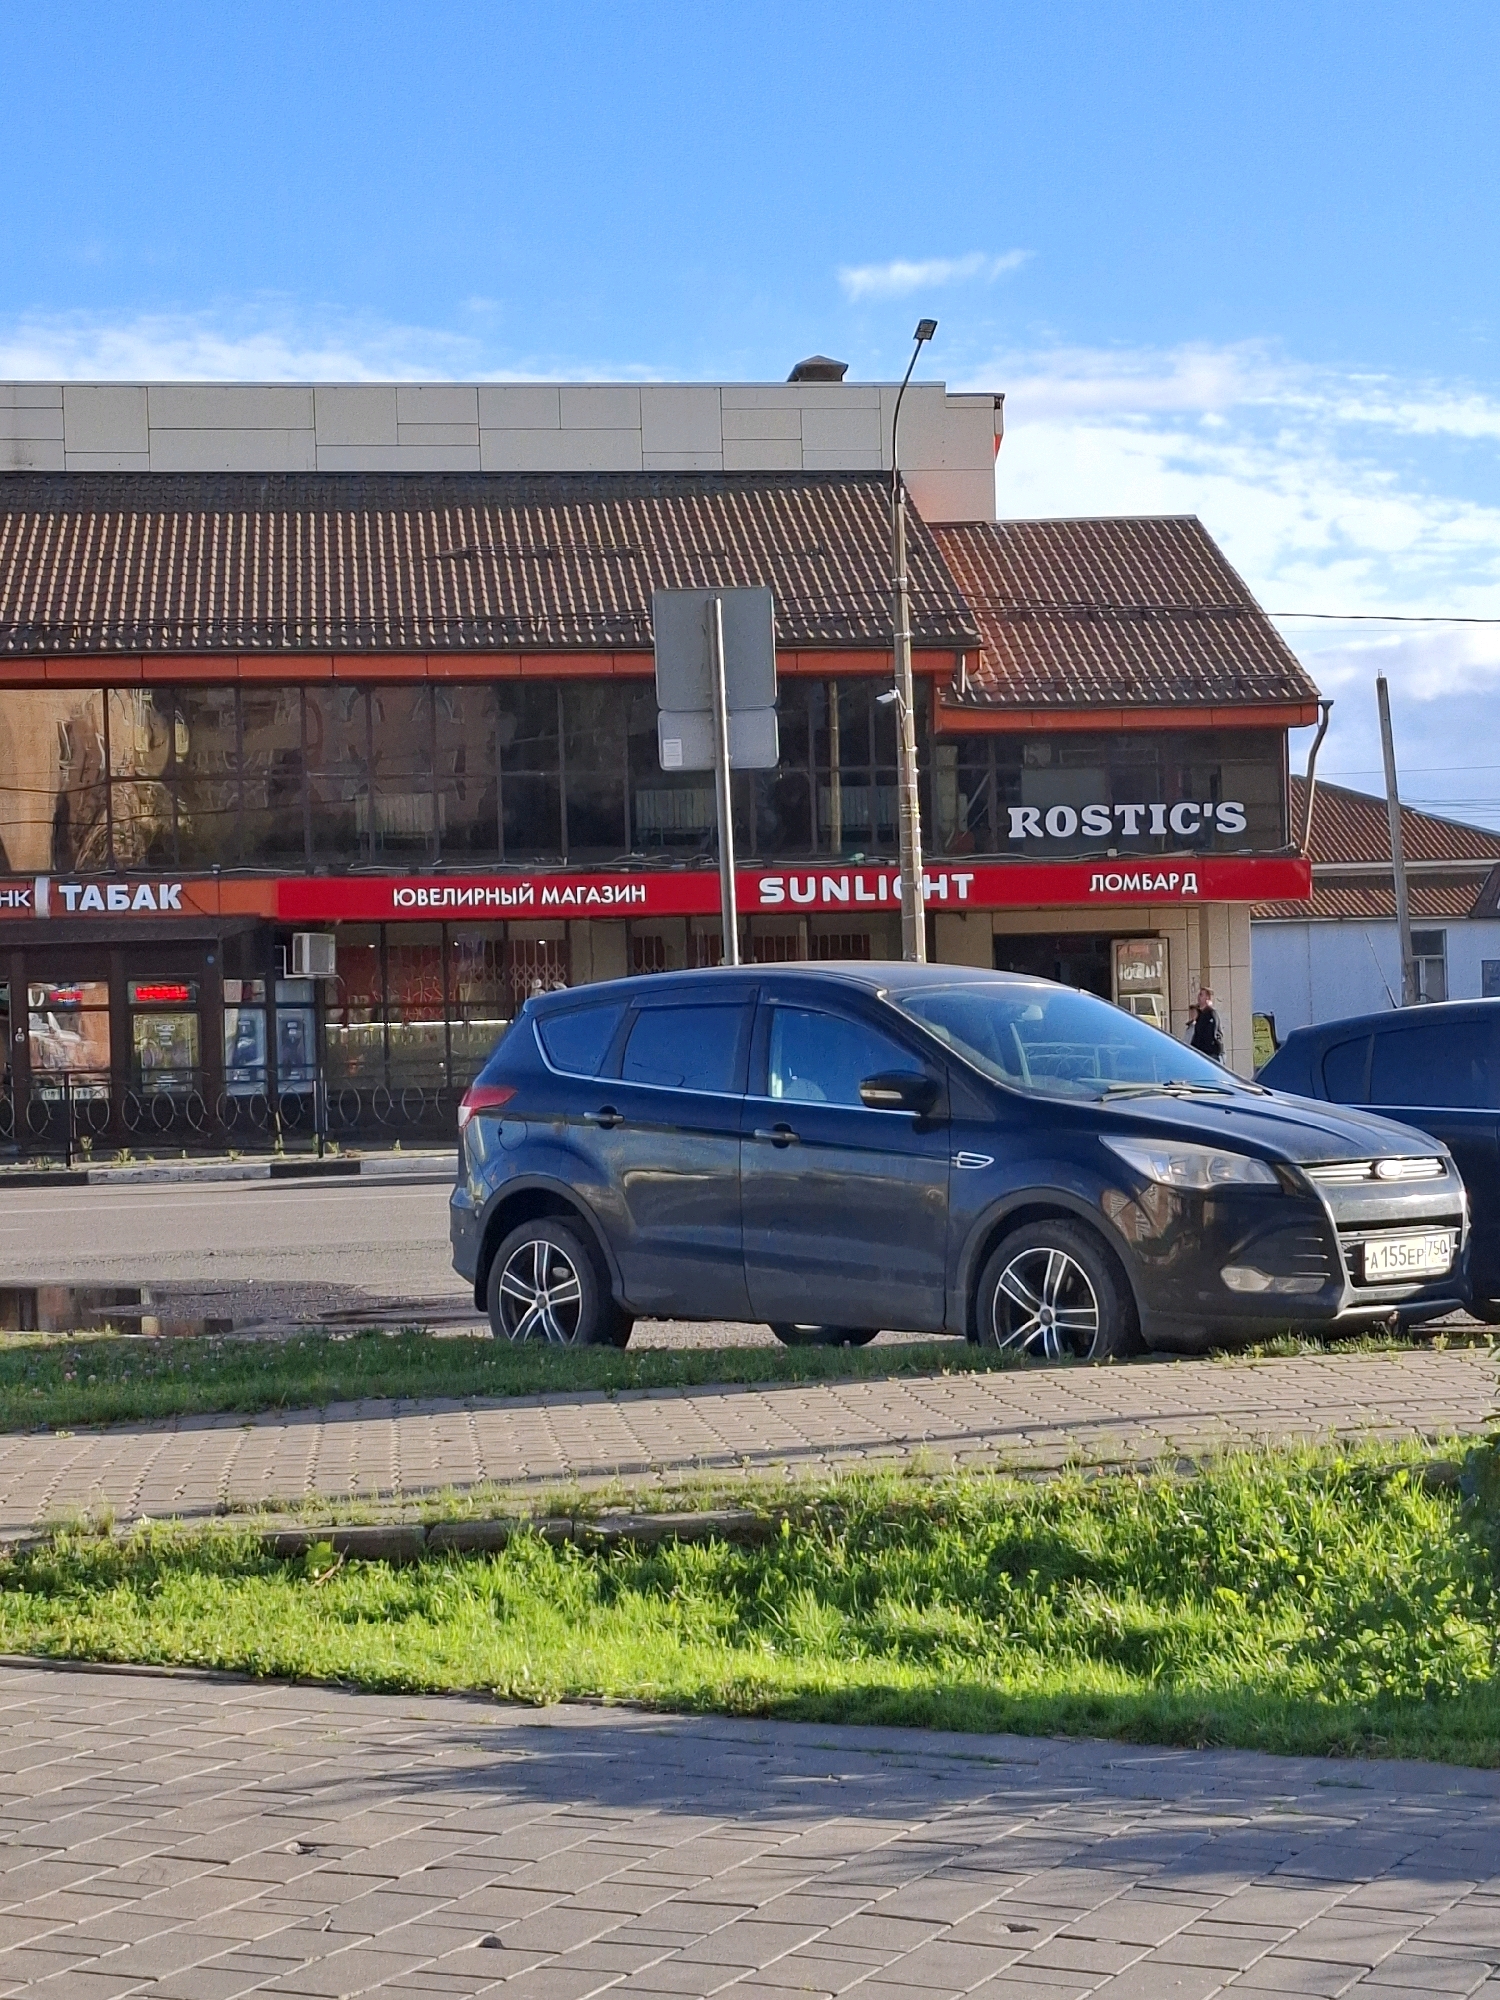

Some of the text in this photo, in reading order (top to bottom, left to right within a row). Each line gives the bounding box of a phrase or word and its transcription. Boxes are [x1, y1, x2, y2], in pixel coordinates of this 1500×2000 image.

[1007, 801, 1247, 838] ROSTIC'S
[393, 882, 646, 907] ЮВЕЛИРНЫЙ МАГАЗИН
[1089, 872, 1198, 894] ЛОМБАРД
[58, 884, 182, 911] ТАБАК
